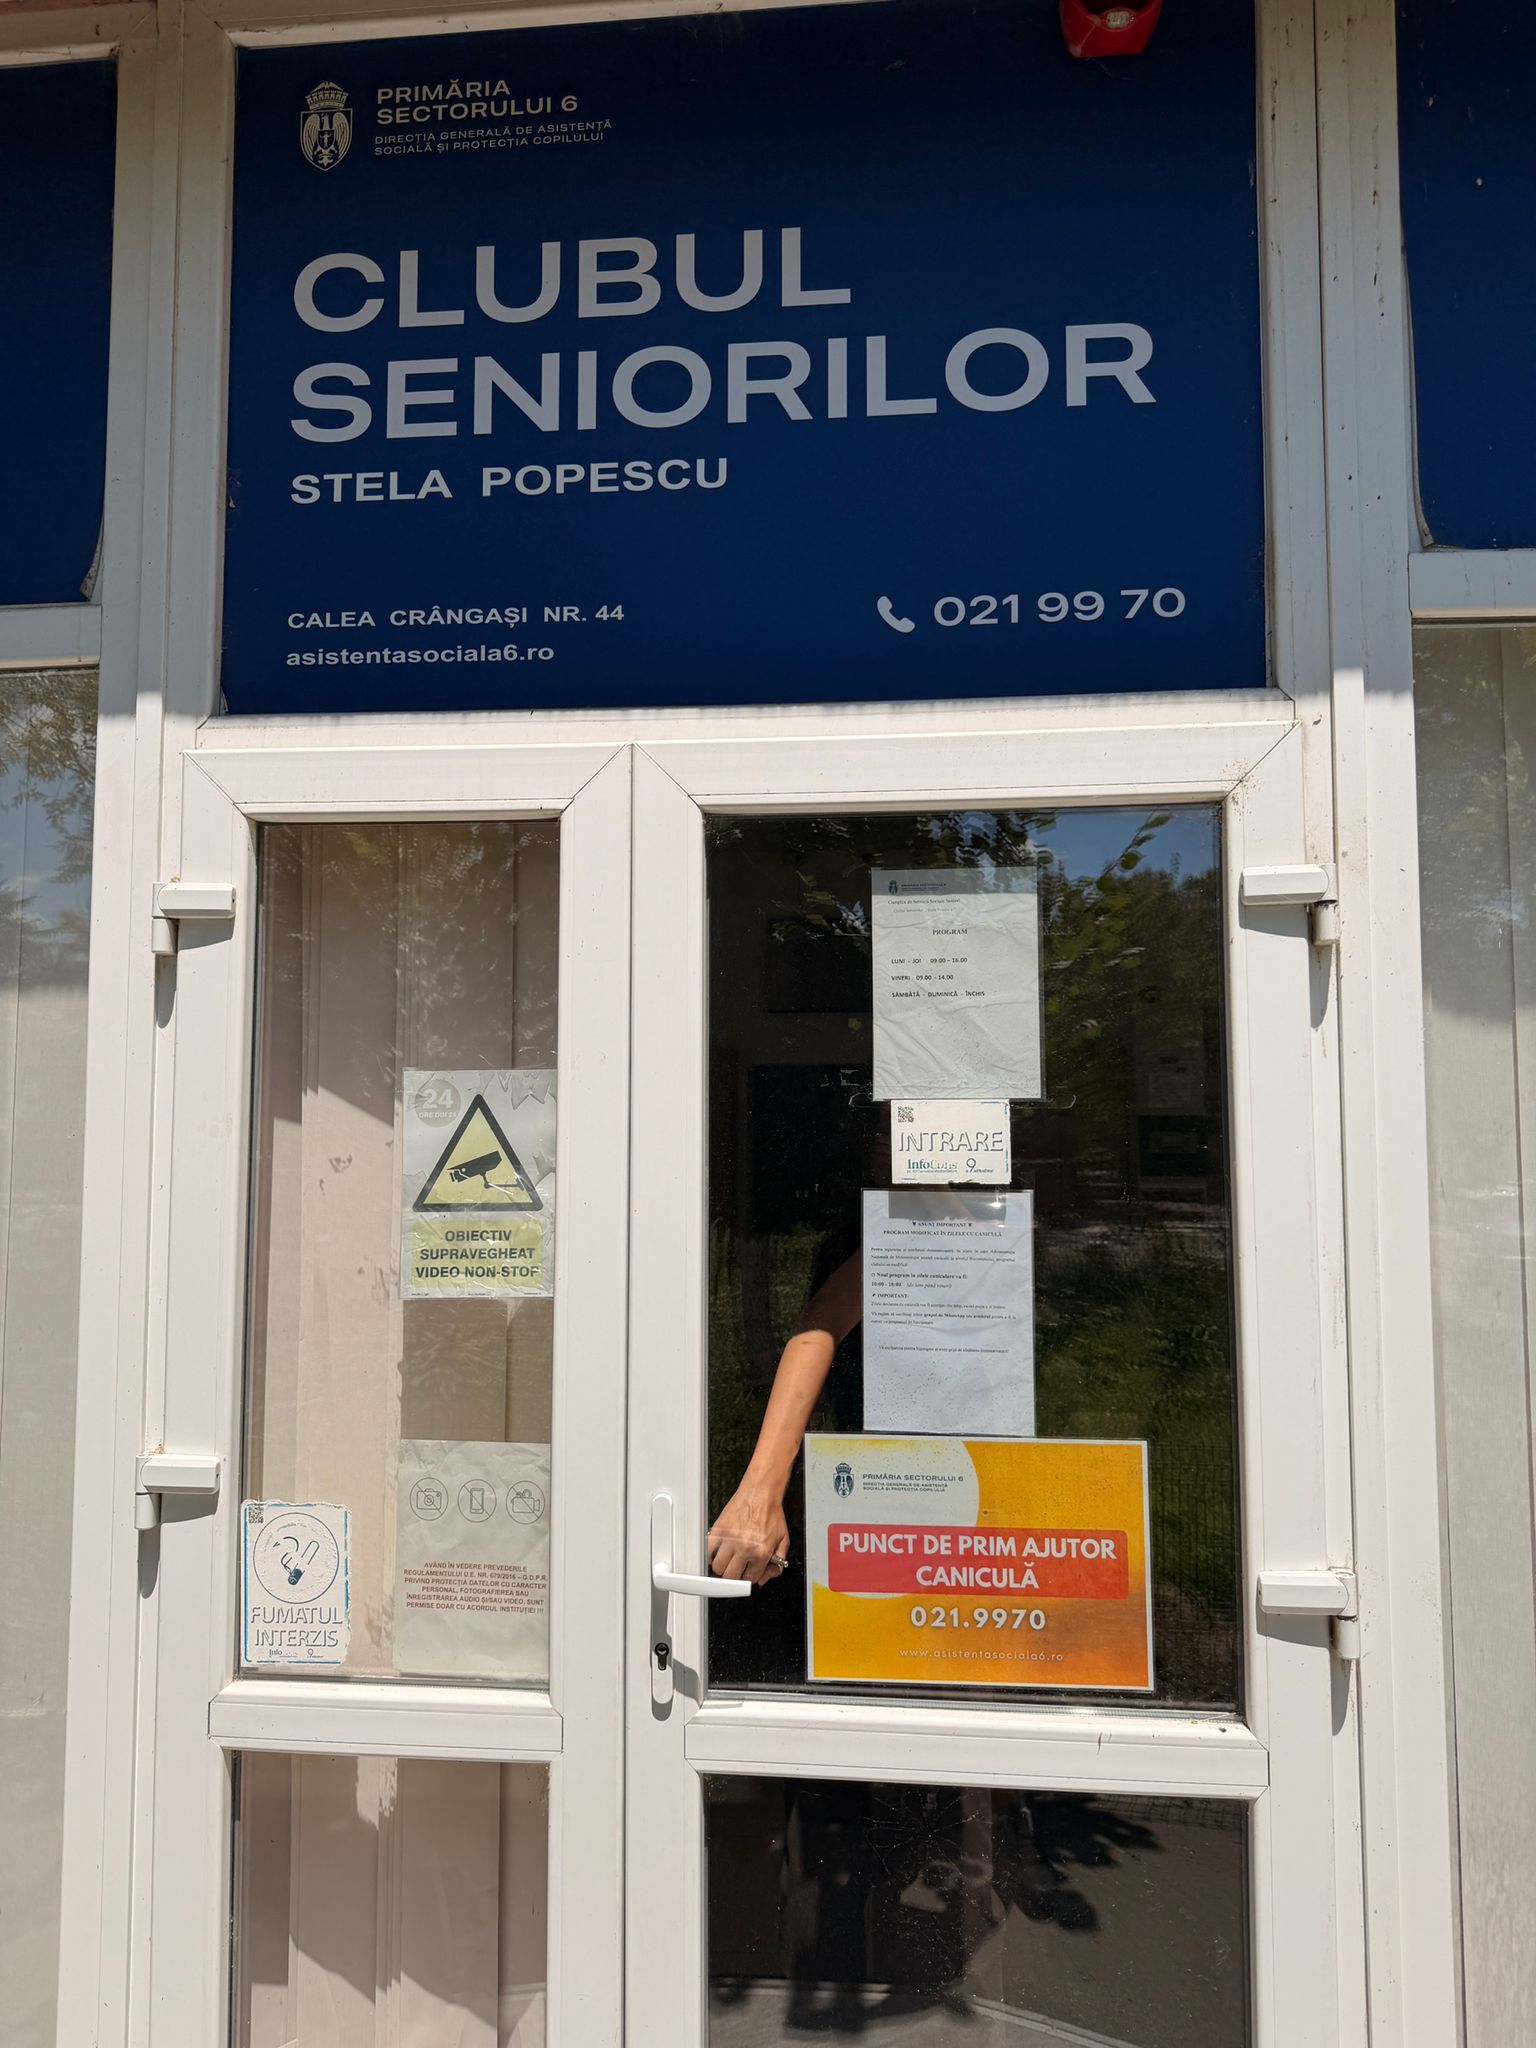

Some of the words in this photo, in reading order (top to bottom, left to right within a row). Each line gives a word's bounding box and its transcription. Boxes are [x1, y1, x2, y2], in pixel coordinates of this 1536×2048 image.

[376, 78, 511, 104] PRIMĂRIA
[376, 97, 552, 125] SECTORULUI
[560, 95, 578, 112] 6
[375, 133, 436, 145] DIRECȚIA
[440, 126, 511, 140] GENERALĂ
[515, 126, 533, 135] DE
[537, 119, 613, 133] ASISTENȚĂ
[374, 143, 432, 156] SOCIALĂ
[437, 142, 449, 154] ȘI
[453, 138, 528, 151] PROTECȚIA
[532, 132, 604, 145] COPILULUI
[293, 226, 852, 333] CLUBUL
[290, 321, 1158, 443] SENIORILOR
[290, 468, 453, 505] STELA
[481, 456, 729, 497] POPESCU
[287, 611, 376, 629] CALEA
[389, 606, 528, 628] CRÂNGAȘI
[543, 606, 587, 622] NR.
[595, 605, 625, 621] 44
[933, 594, 1019, 627] 021
[1037, 590, 1105, 622] 99
[1120, 587, 1186, 619] 70
[286, 644, 555, 666] asistentasociala6.ro
[423, 1089, 454, 1109] 24
[899, 1131, 1004, 1152] INTRARE
[444, 1230, 513, 1242] OBIECTIV
[420, 1248, 536, 1260] SUPRAVEGHEAT
[415, 1266, 460, 1278] VIDEO
[464, 1266, 540, 1278] NON-STOP
[862, 1473, 902, 1481] PRIMĂRIA
[904, 1474, 956, 1482] SECTORULUI
[839, 1532, 917, 1555] PUNCT
[923, 1534, 952, 1556] DE
[958, 1535, 1017, 1557] PRIM
[1022, 1537, 1117, 1560] AJUTOR
[404, 1569, 462, 1577] REGULAMENTULUI
[448, 1561, 454, 1569] ÎN
[483, 1564, 527, 1572] PREVEDERILE
[916, 1561, 1040, 1589] CANICULĂ
[431, 1578, 467, 1587] PROTECȚIA
[460, 1588, 514, 1596] FOTOGRAFIEREA
[406, 1593, 458, 1601] ÎNREGISTRAREA
[406, 1601, 435, 1609] PERMISE
[466, 1604, 498, 1612] ACORDUL
[250, 1606, 343, 1625] FUMATUL
[910, 1606, 1047, 1631] 021.9970
[255, 1629, 339, 1647] INTERZIS
[899, 1648, 1064, 1662] www.asistentasociala6.ro
